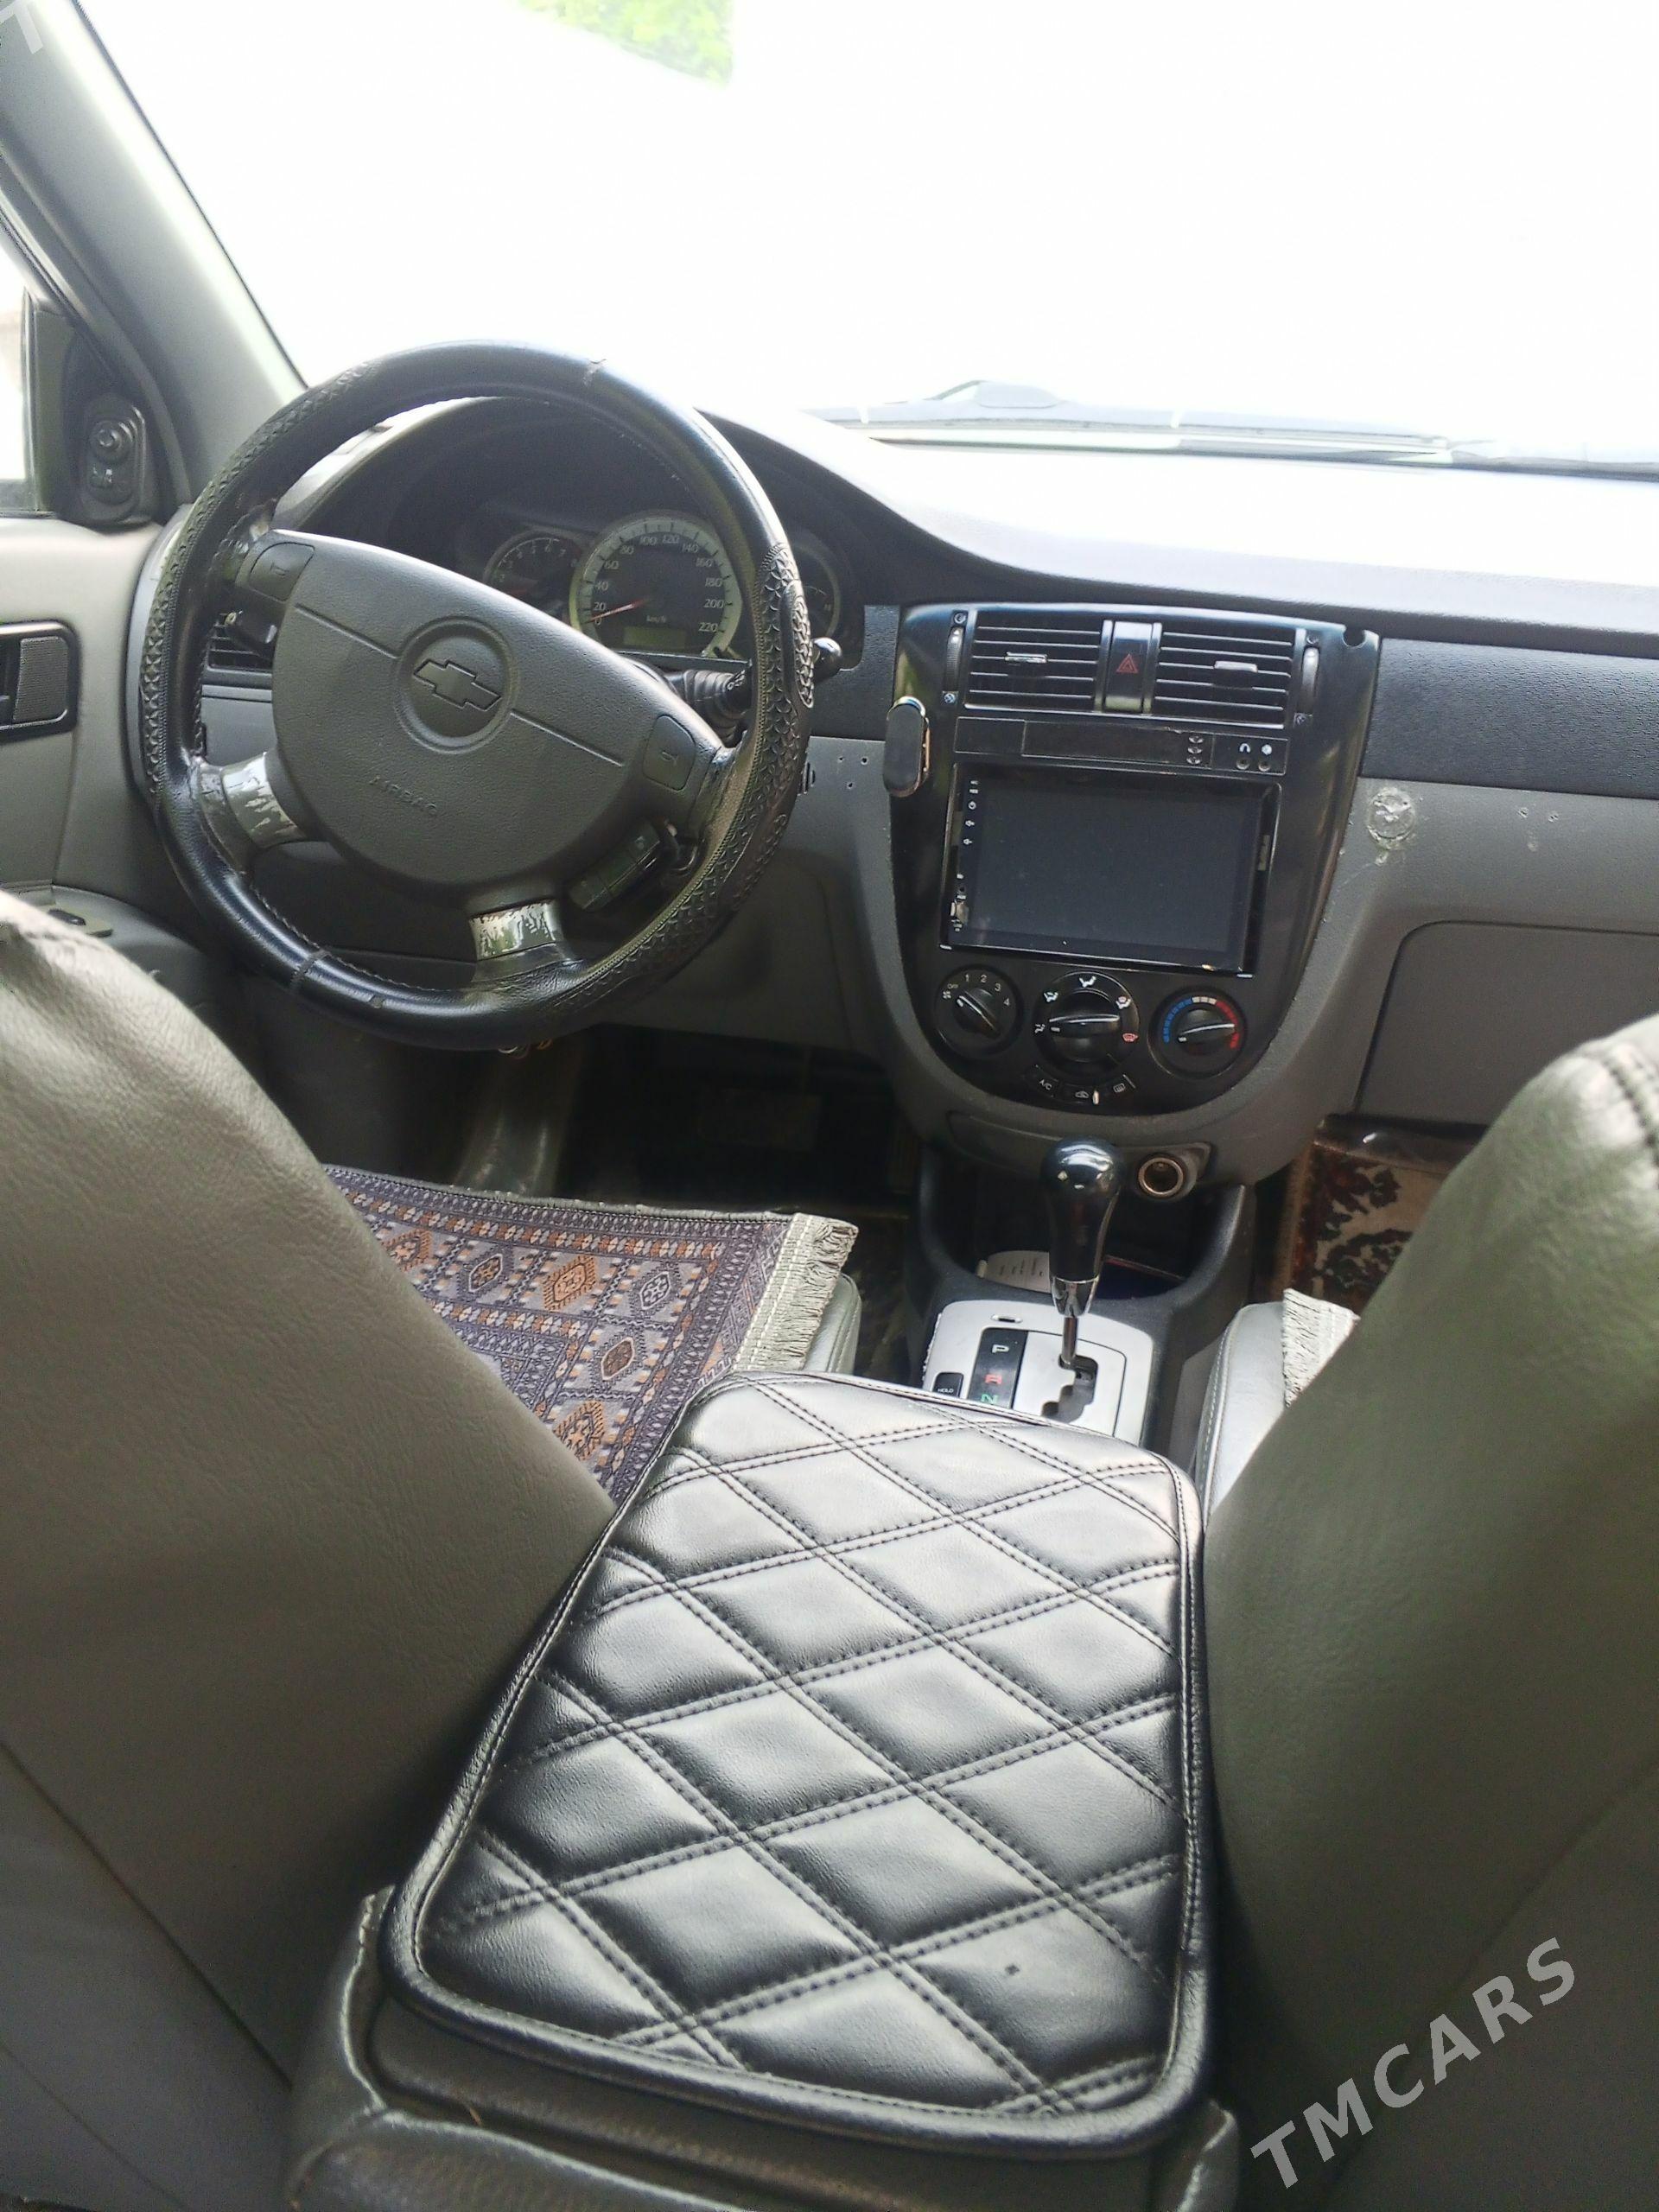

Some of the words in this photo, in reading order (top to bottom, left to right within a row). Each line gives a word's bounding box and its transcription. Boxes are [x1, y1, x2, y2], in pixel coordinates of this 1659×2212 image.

[639, 536, 658, 546] 100
[663, 535, 680, 544] 120
[620, 545, 635, 555] 80
[683, 543, 699, 553] 140
[605, 560, 620, 569] 60
[696, 559, 714, 568] 160
[595, 581, 609, 591] 40
[705, 578, 723, 588] 180
[594, 601, 607, 611] 20
[703, 599, 725, 609] 200
[698, 623, 719, 632] 220
[980, 974, 988, 983] 2
[995, 982, 1001, 992] 3
[1003, 997, 1010, 1007] 4
[1039, 1078, 1052, 1091] A/C
[991, 1344, 1010, 1354] P
